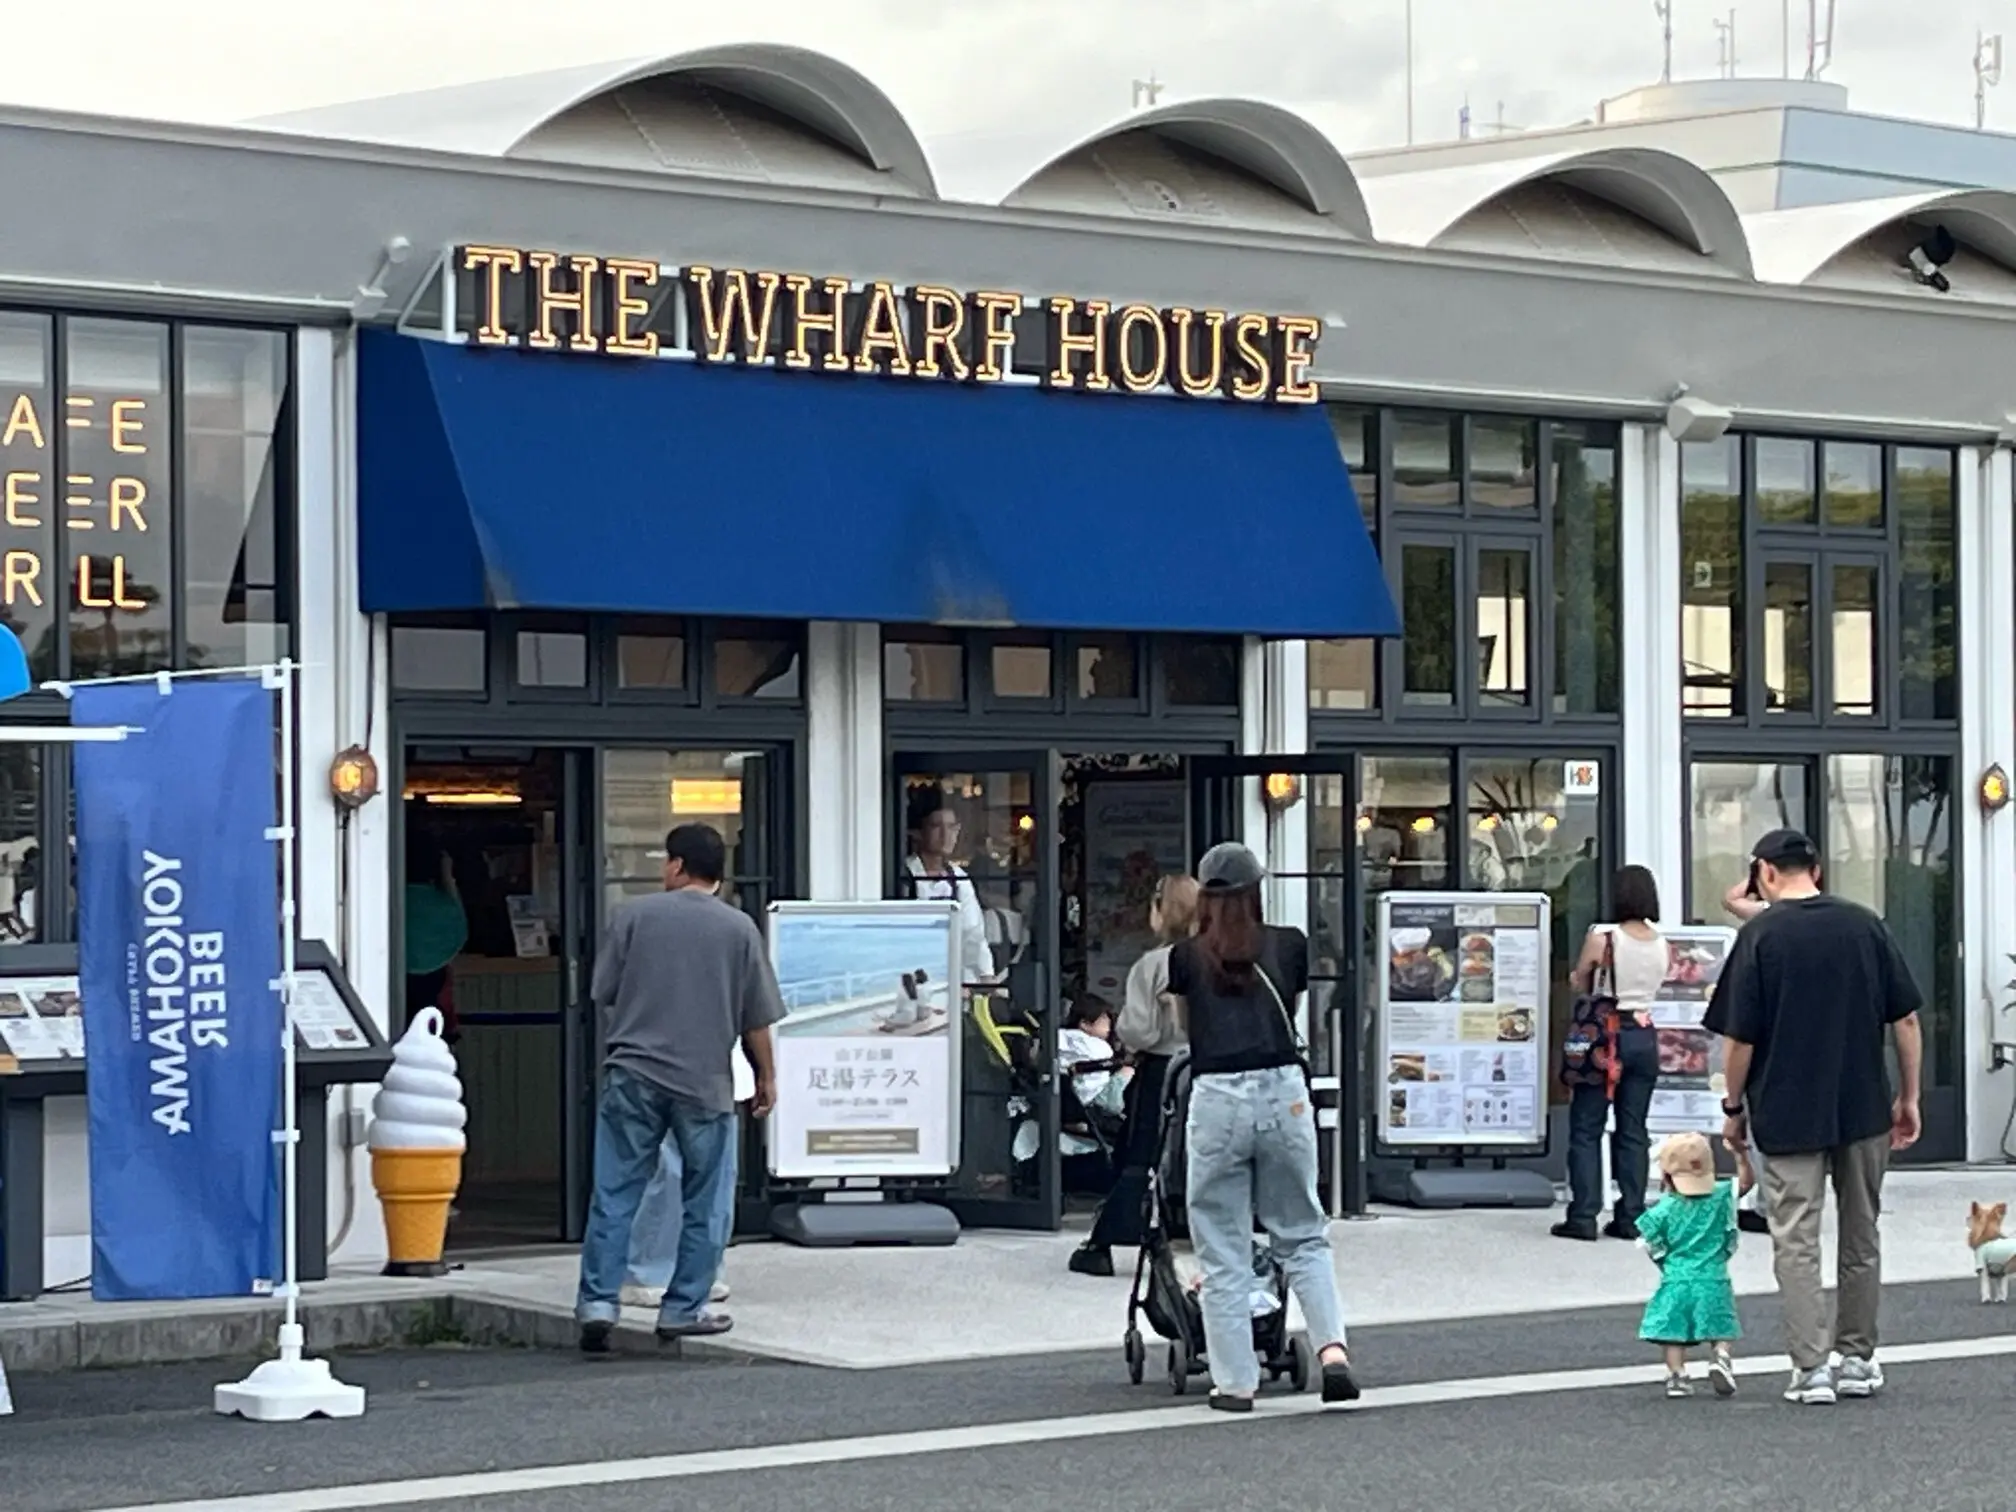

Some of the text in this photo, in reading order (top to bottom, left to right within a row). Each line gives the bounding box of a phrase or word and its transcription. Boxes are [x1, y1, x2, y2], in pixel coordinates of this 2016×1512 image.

[458, 244, 1323, 406] THE WHARF HOUSE
[3, 472, 149, 532] EER
[3, 551, 149, 610] RLL
[806, 1067, 920, 1091] 足湯テラス
